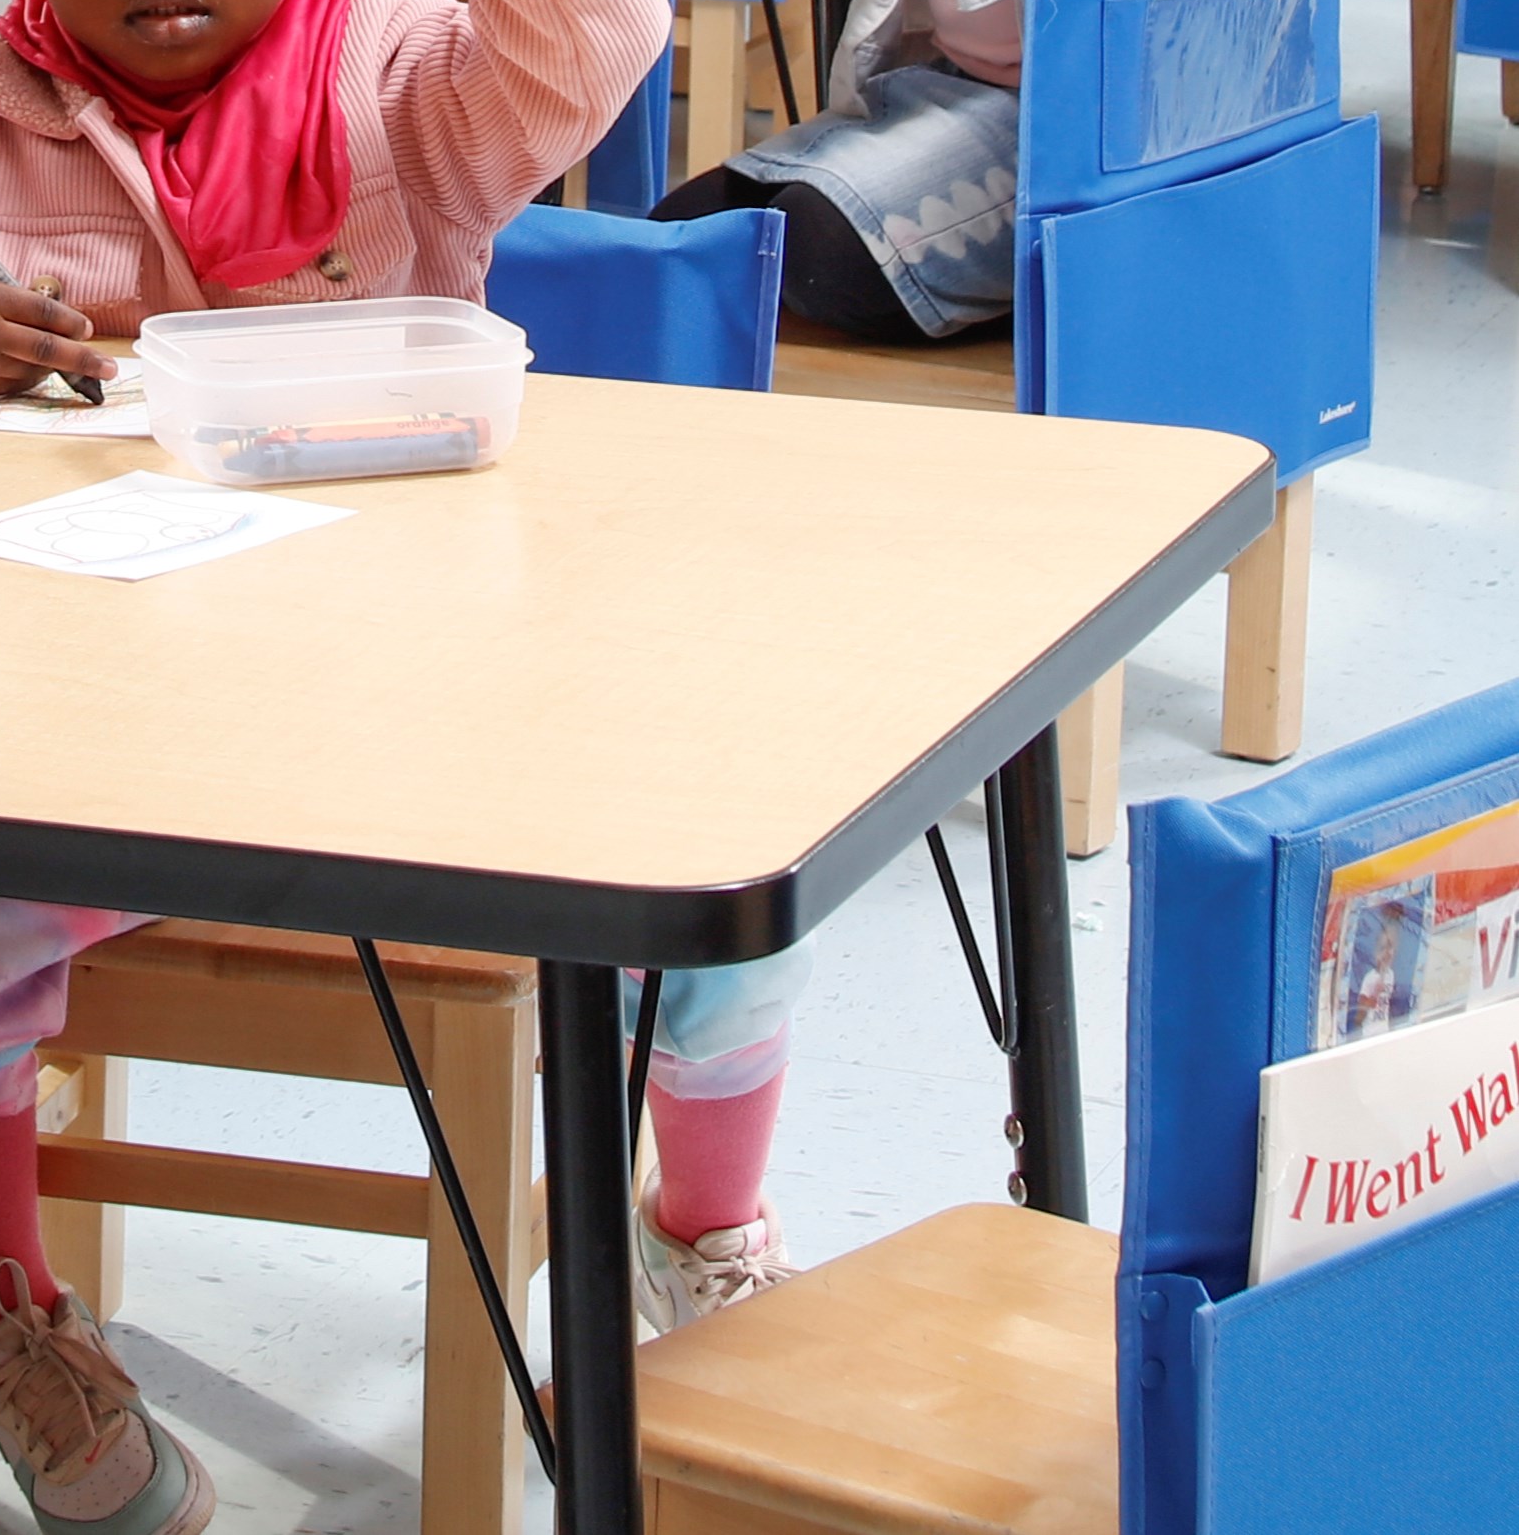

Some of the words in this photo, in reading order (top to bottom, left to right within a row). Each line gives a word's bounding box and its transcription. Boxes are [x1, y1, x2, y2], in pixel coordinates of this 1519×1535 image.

[396, 418, 451, 432] orange
[1478, 911, 1519, 990] Vi
[1288, 1154, 1319, 1222] I
[1325, 1124, 1447, 1225] Went
[1449, 1040, 1519, 1156] Wal
